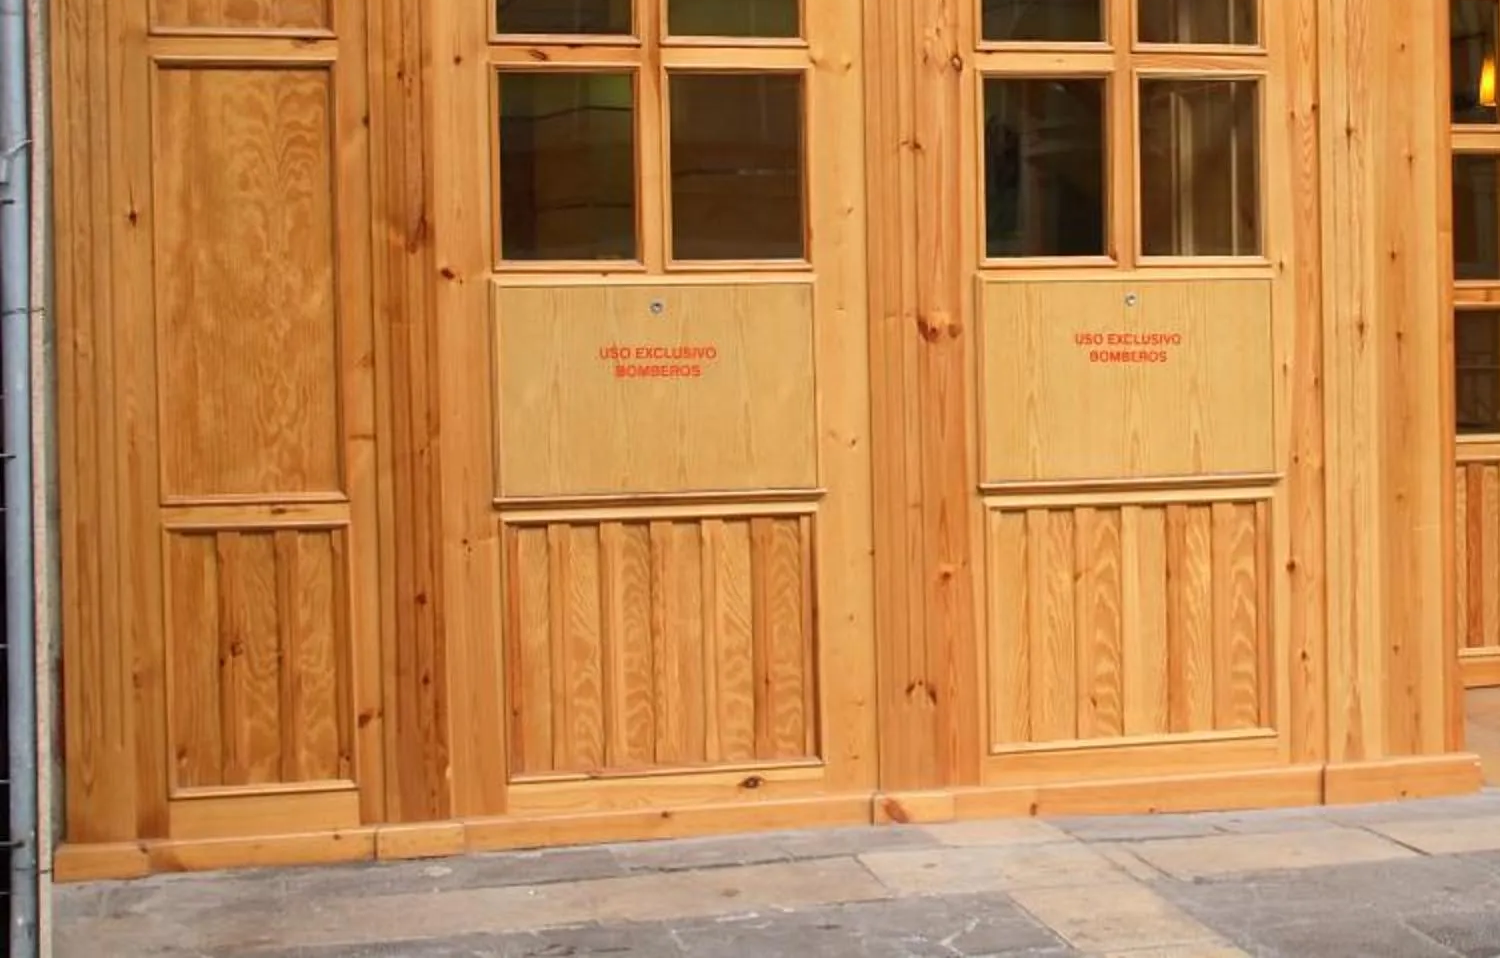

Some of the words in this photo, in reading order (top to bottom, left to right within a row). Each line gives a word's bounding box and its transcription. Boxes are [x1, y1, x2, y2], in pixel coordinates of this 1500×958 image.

[1074, 332, 1104, 345] USO
[1107, 332, 1182, 346] EXCLUSIVO
[599, 345, 632, 359] USO
[635, 345, 718, 360] EXCLUSIVO
[1088, 349, 1168, 363] BOMBEROS
[615, 364, 702, 378] BOMBEROS
